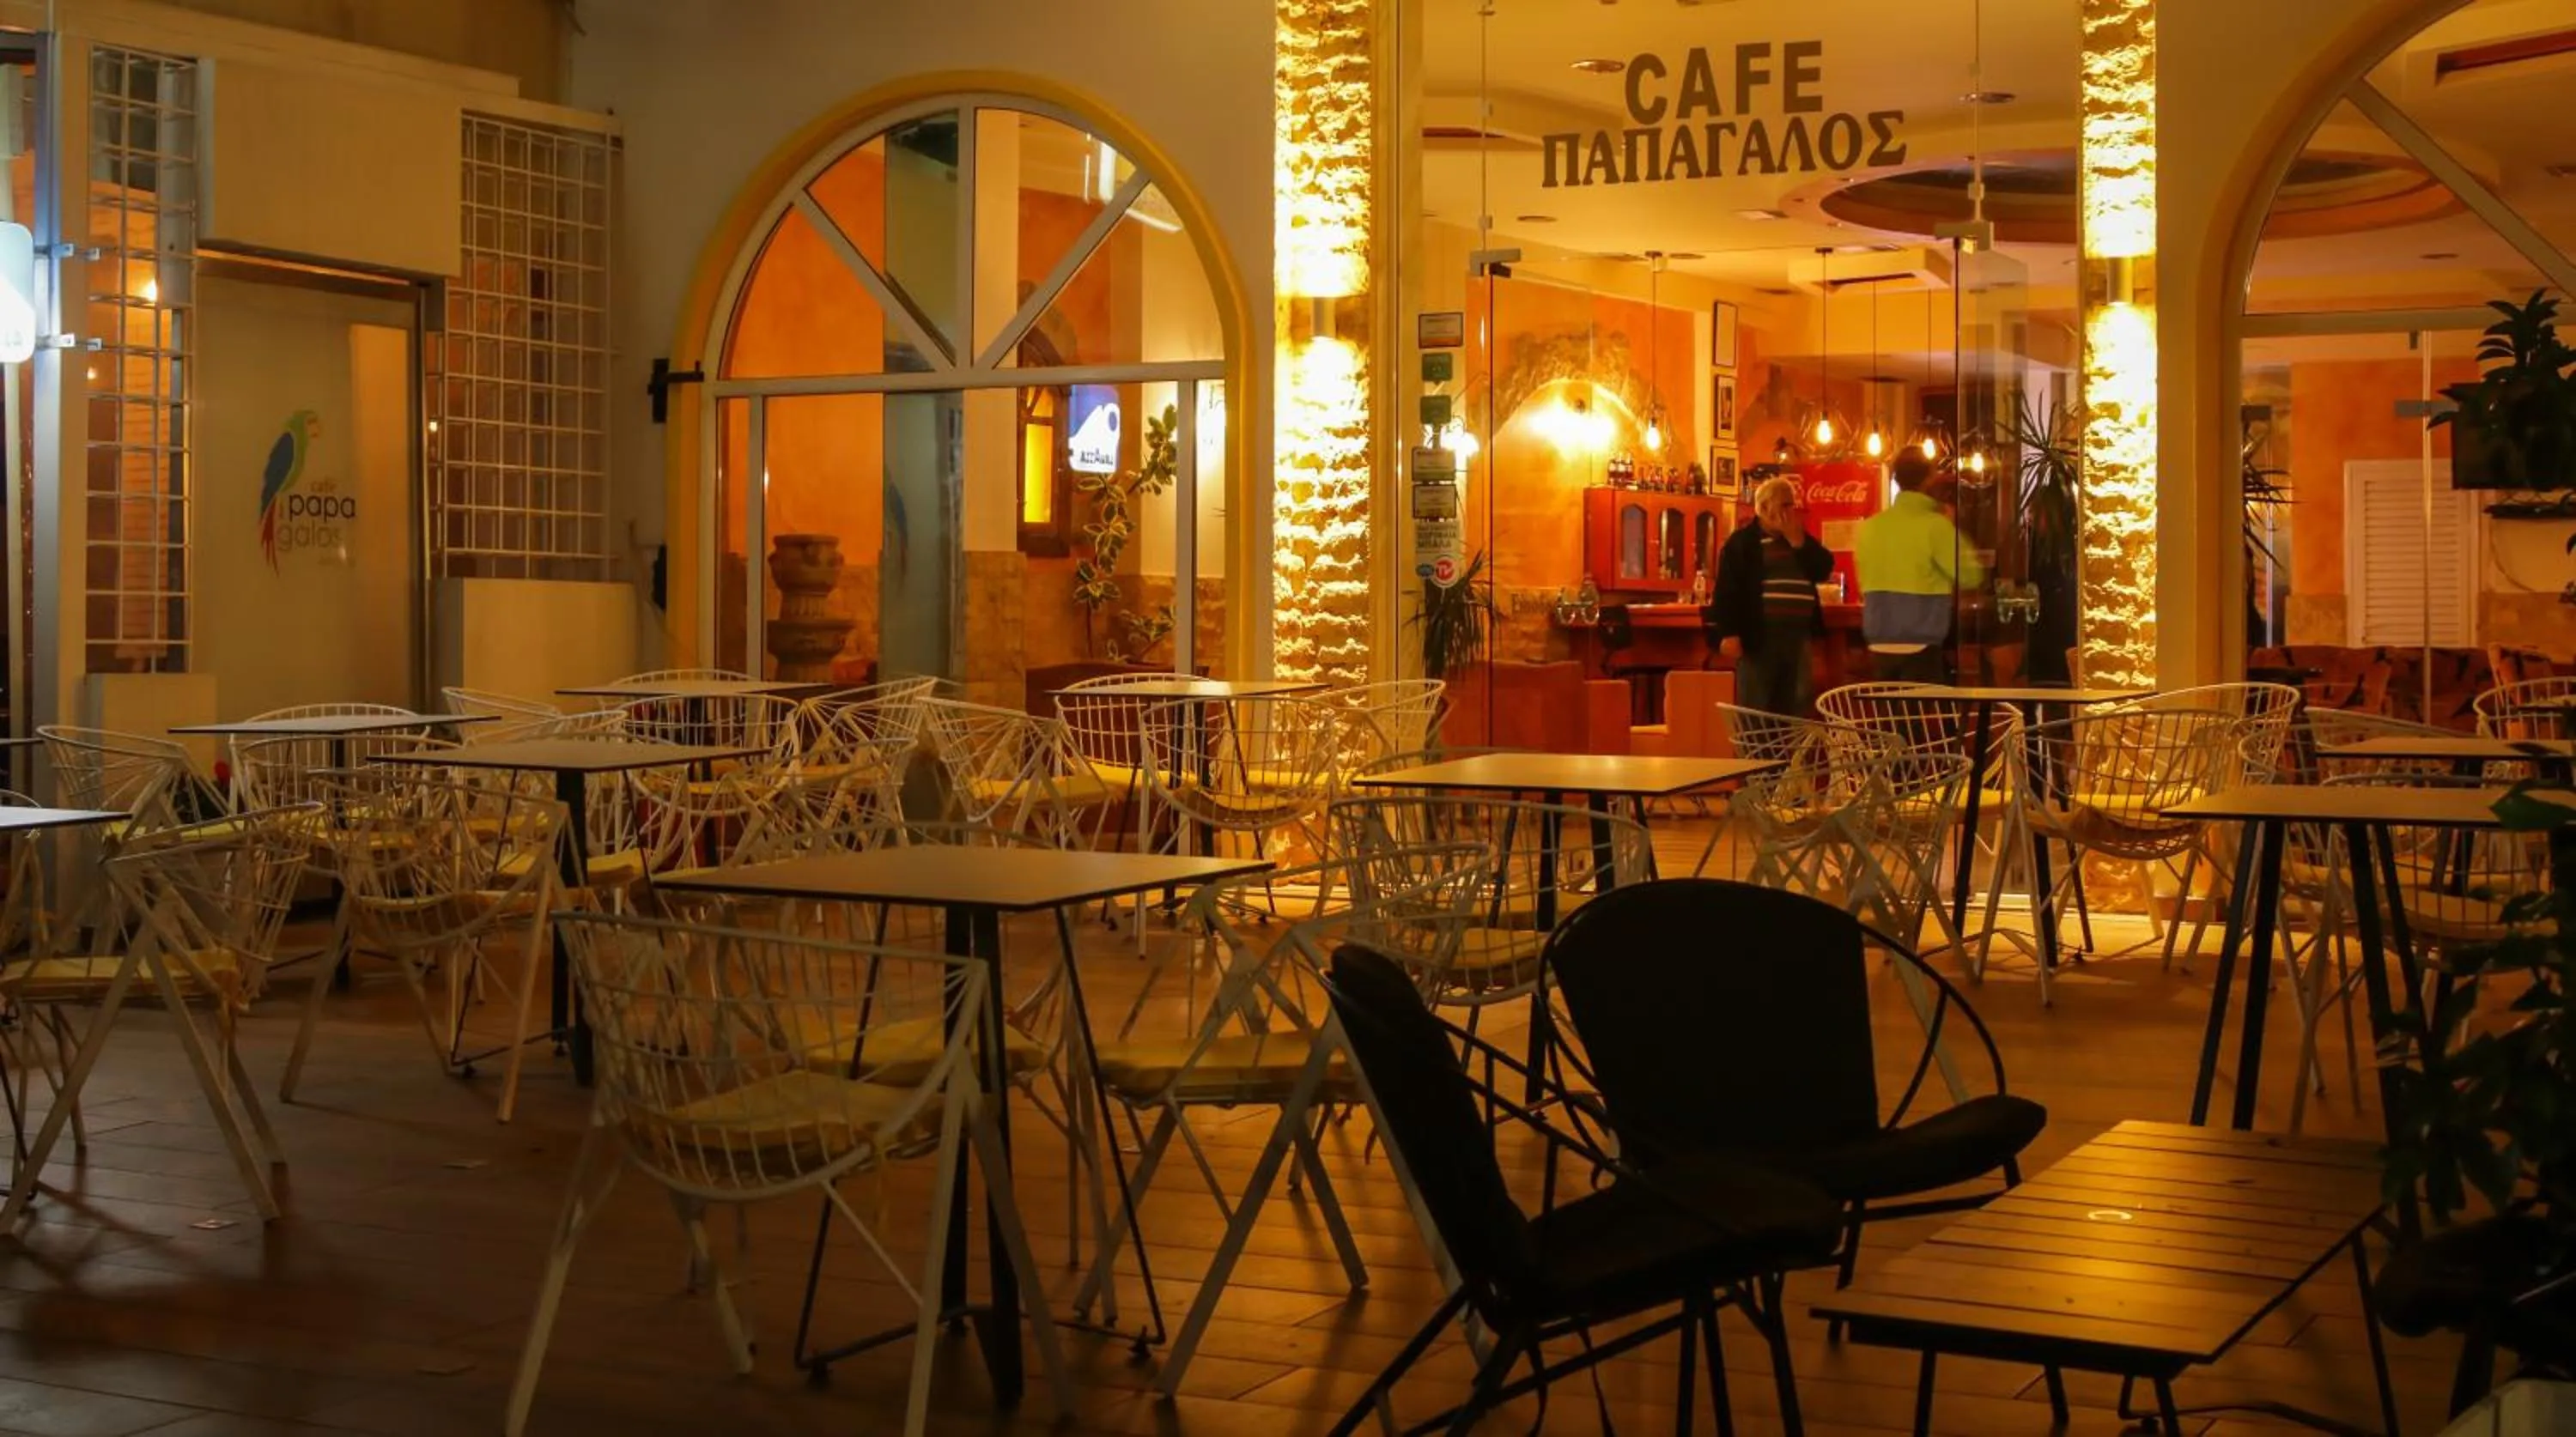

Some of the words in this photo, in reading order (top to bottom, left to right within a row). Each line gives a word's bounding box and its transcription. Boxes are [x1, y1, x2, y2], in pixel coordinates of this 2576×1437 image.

[1625, 40, 1823, 124] CAFE
[1542, 110, 1907, 188] ΠΑΠΑΓΑΛΟΣ
[289, 494, 355, 523] papa
